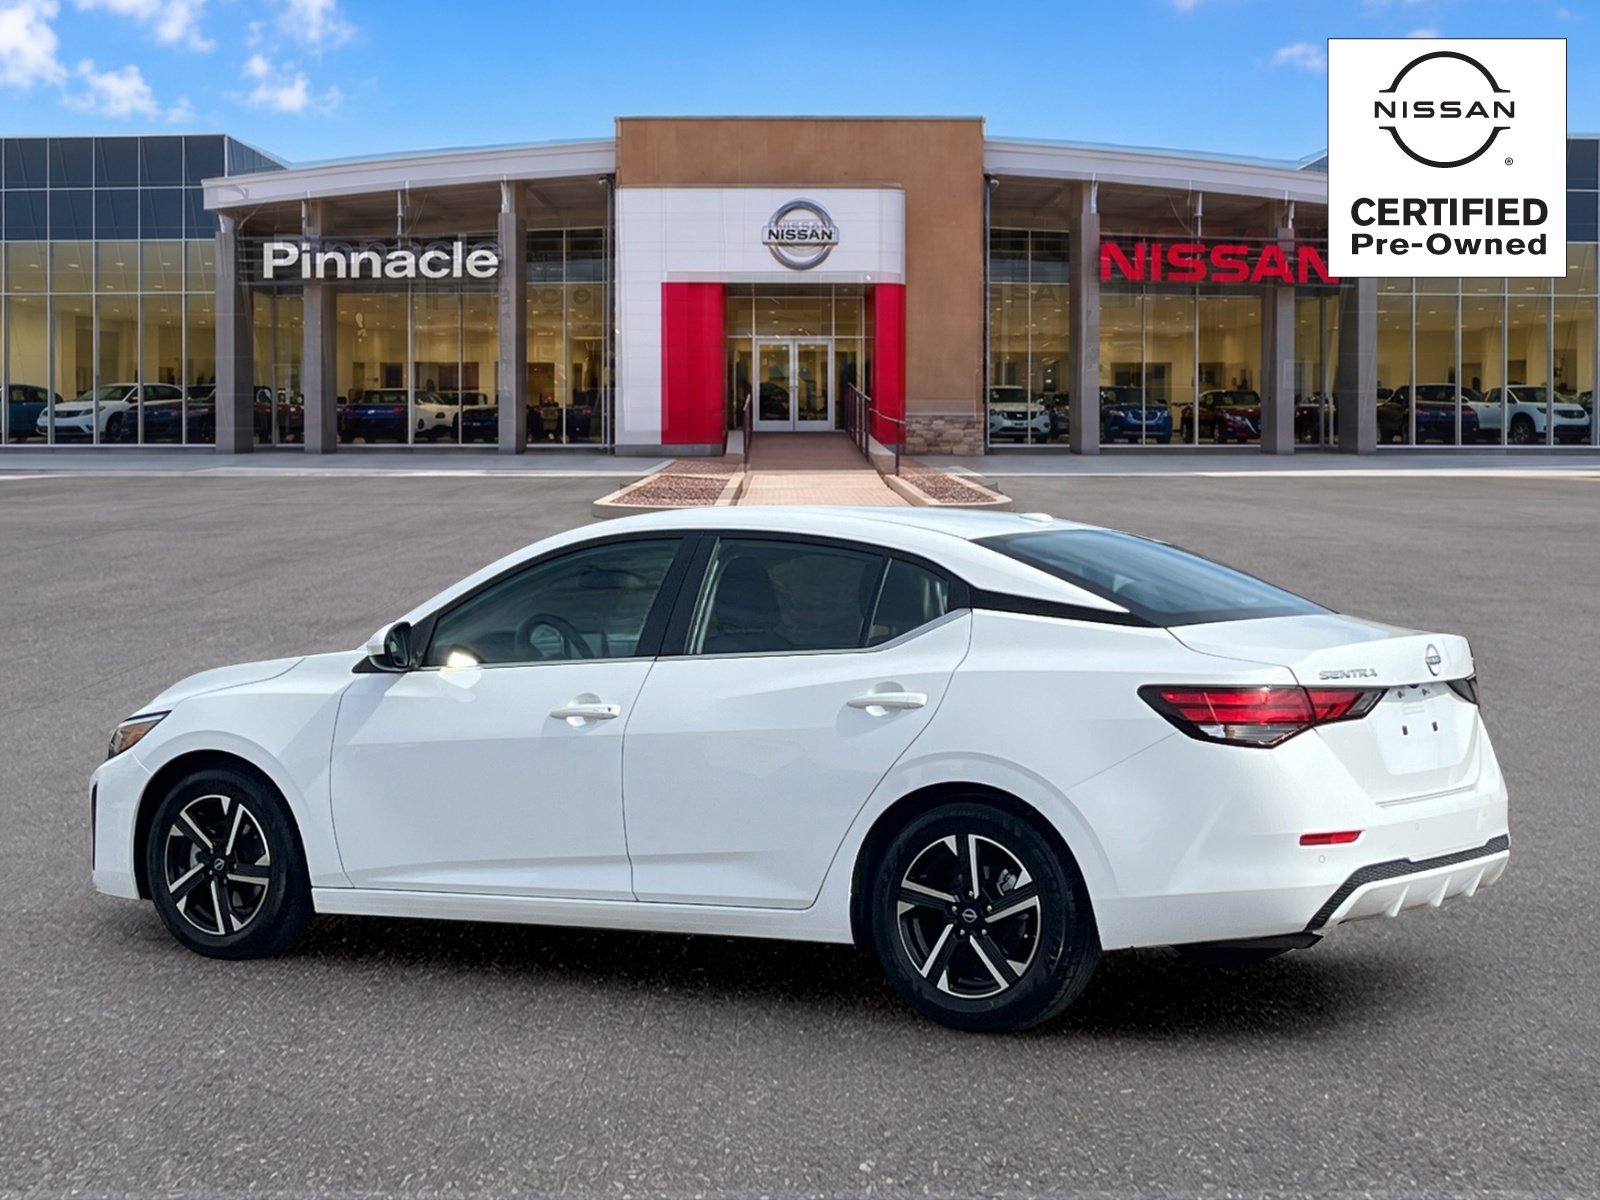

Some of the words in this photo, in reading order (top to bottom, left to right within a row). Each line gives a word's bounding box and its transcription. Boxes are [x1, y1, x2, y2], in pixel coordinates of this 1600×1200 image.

[768, 229, 833, 240] NISSAN
[262, 241, 499, 279] Pinnacle
[1099, 242, 1341, 284] NISSAN
